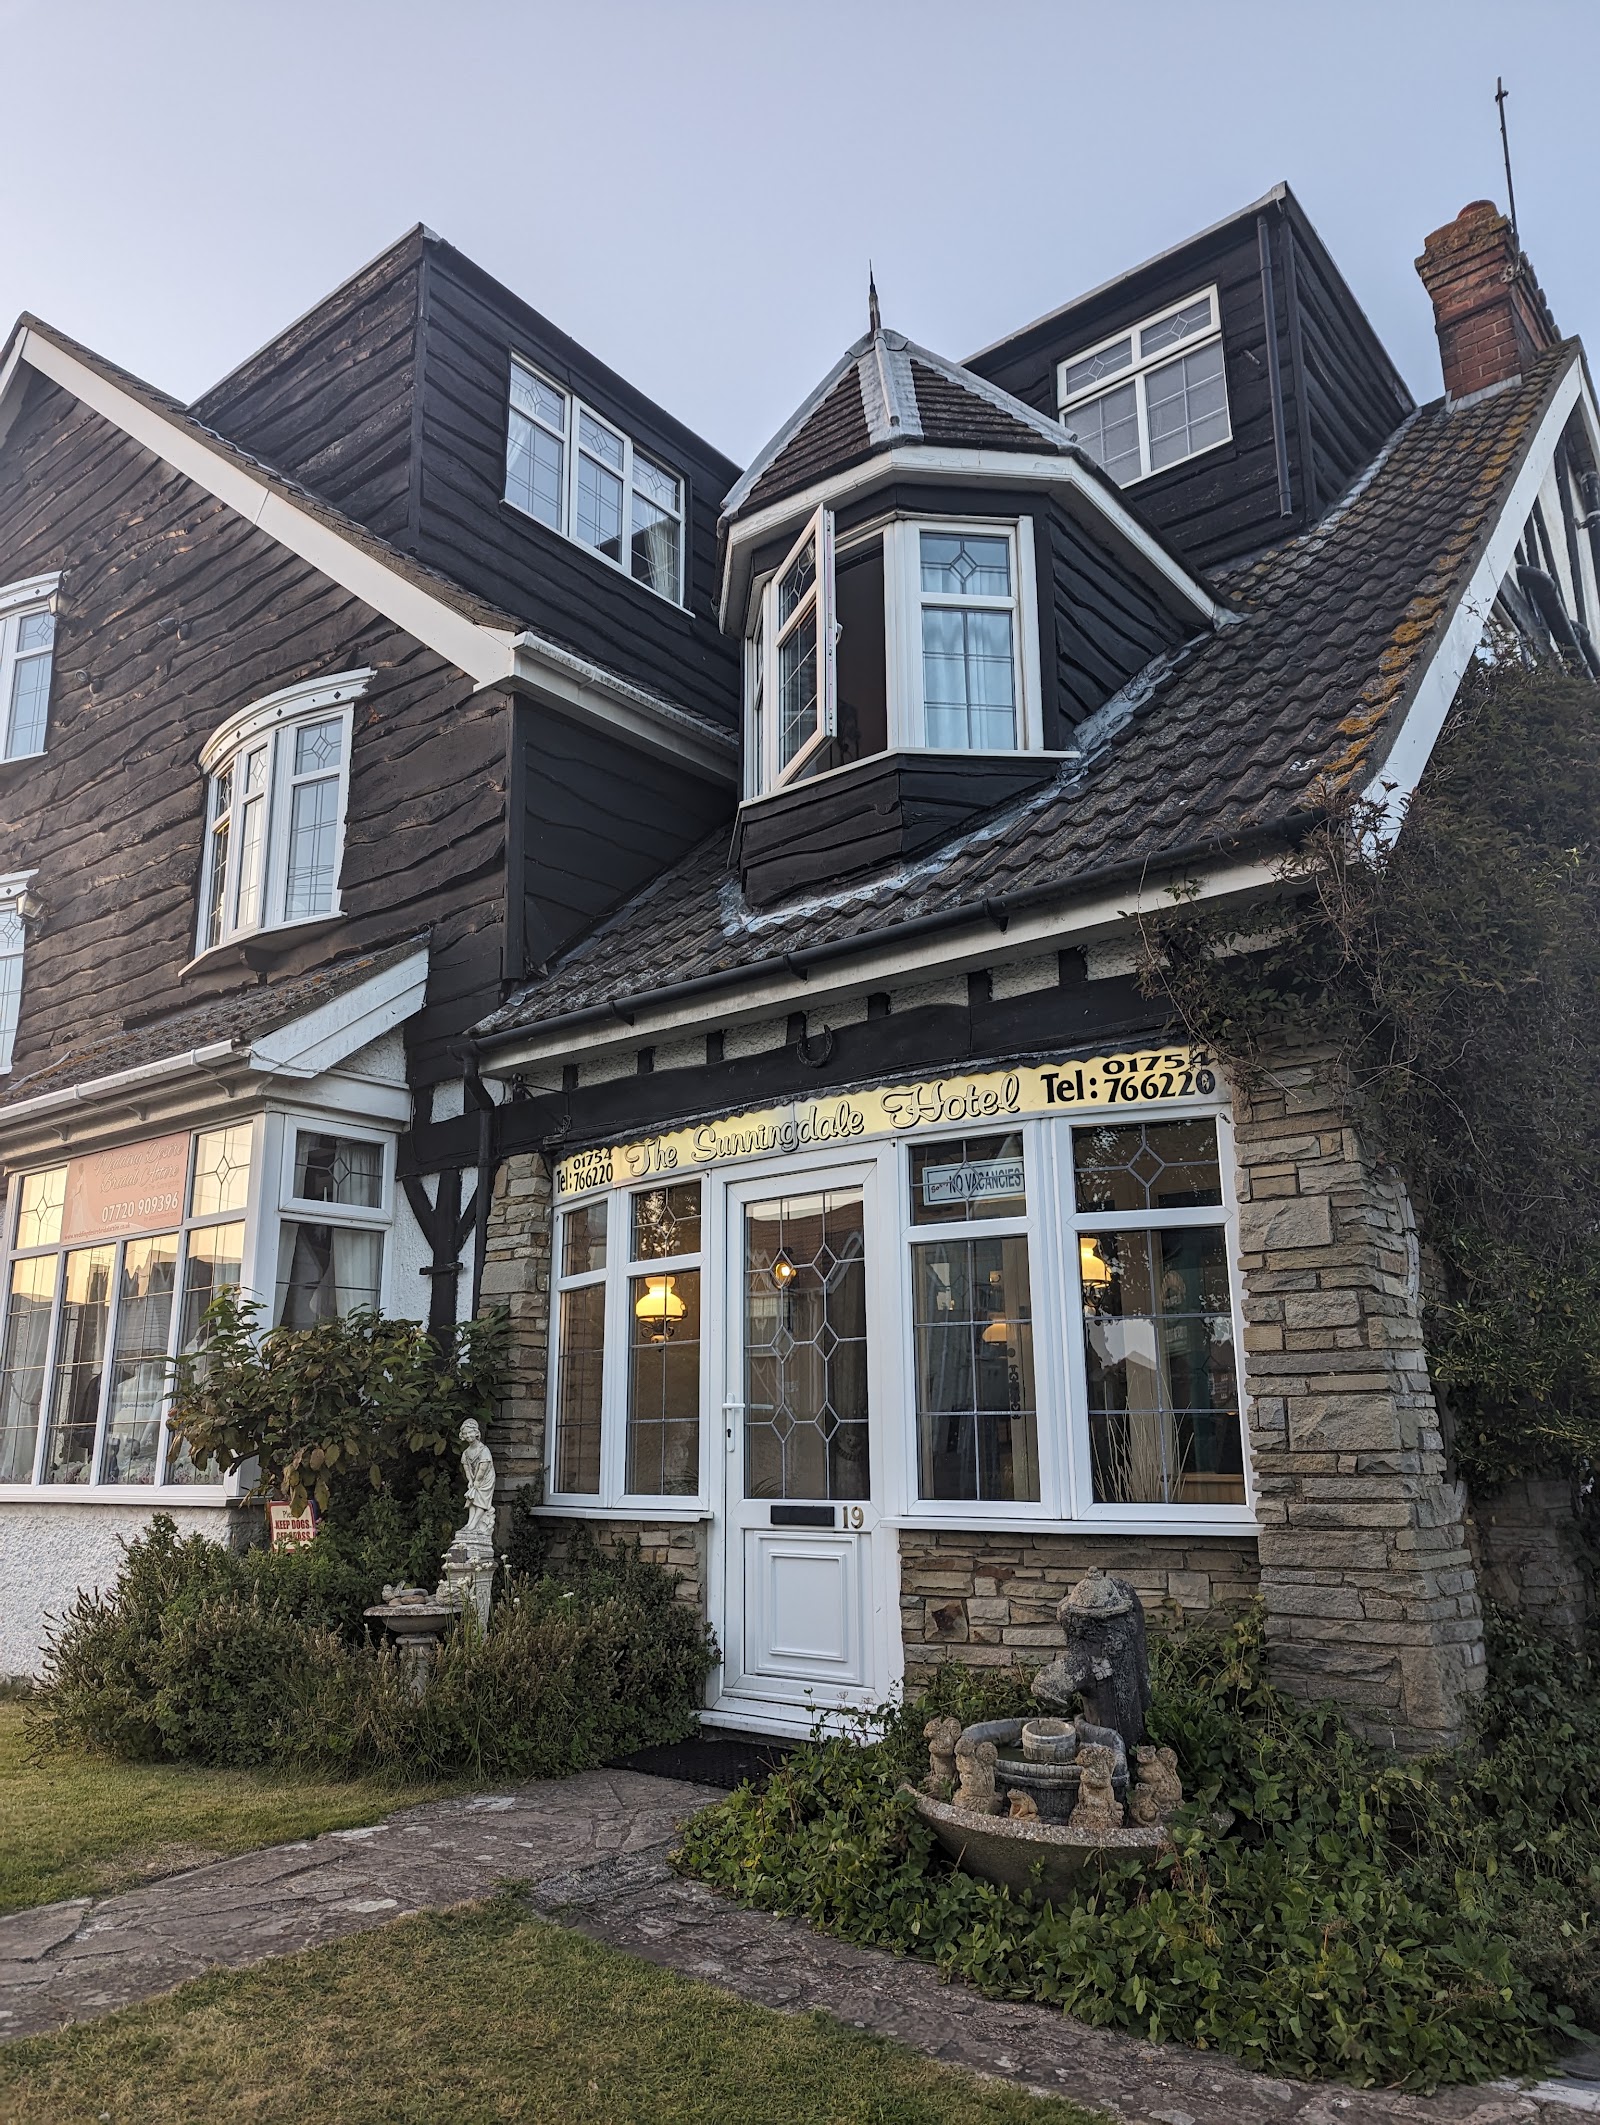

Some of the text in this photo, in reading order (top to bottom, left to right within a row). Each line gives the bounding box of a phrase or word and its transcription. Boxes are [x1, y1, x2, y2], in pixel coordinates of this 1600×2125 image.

[1102, 1051, 1209, 1075] 01754
[1040, 1069, 1216, 1104] Tel: 766220
[625, 1073, 1021, 1178] The Sunningdale Hotel
[573, 1149, 613, 1170] 01754
[556, 1162, 614, 1194] Tel: 766220
[948, 1173, 964, 1194] NO
[964, 1168, 1021, 1192] VACANCIES
[101, 1201, 135, 1223] 07720
[137, 1190, 179, 1216] 909396
[275, 1519, 309, 1529] KEEP DOGS
[842, 1505, 865, 1530] 19
